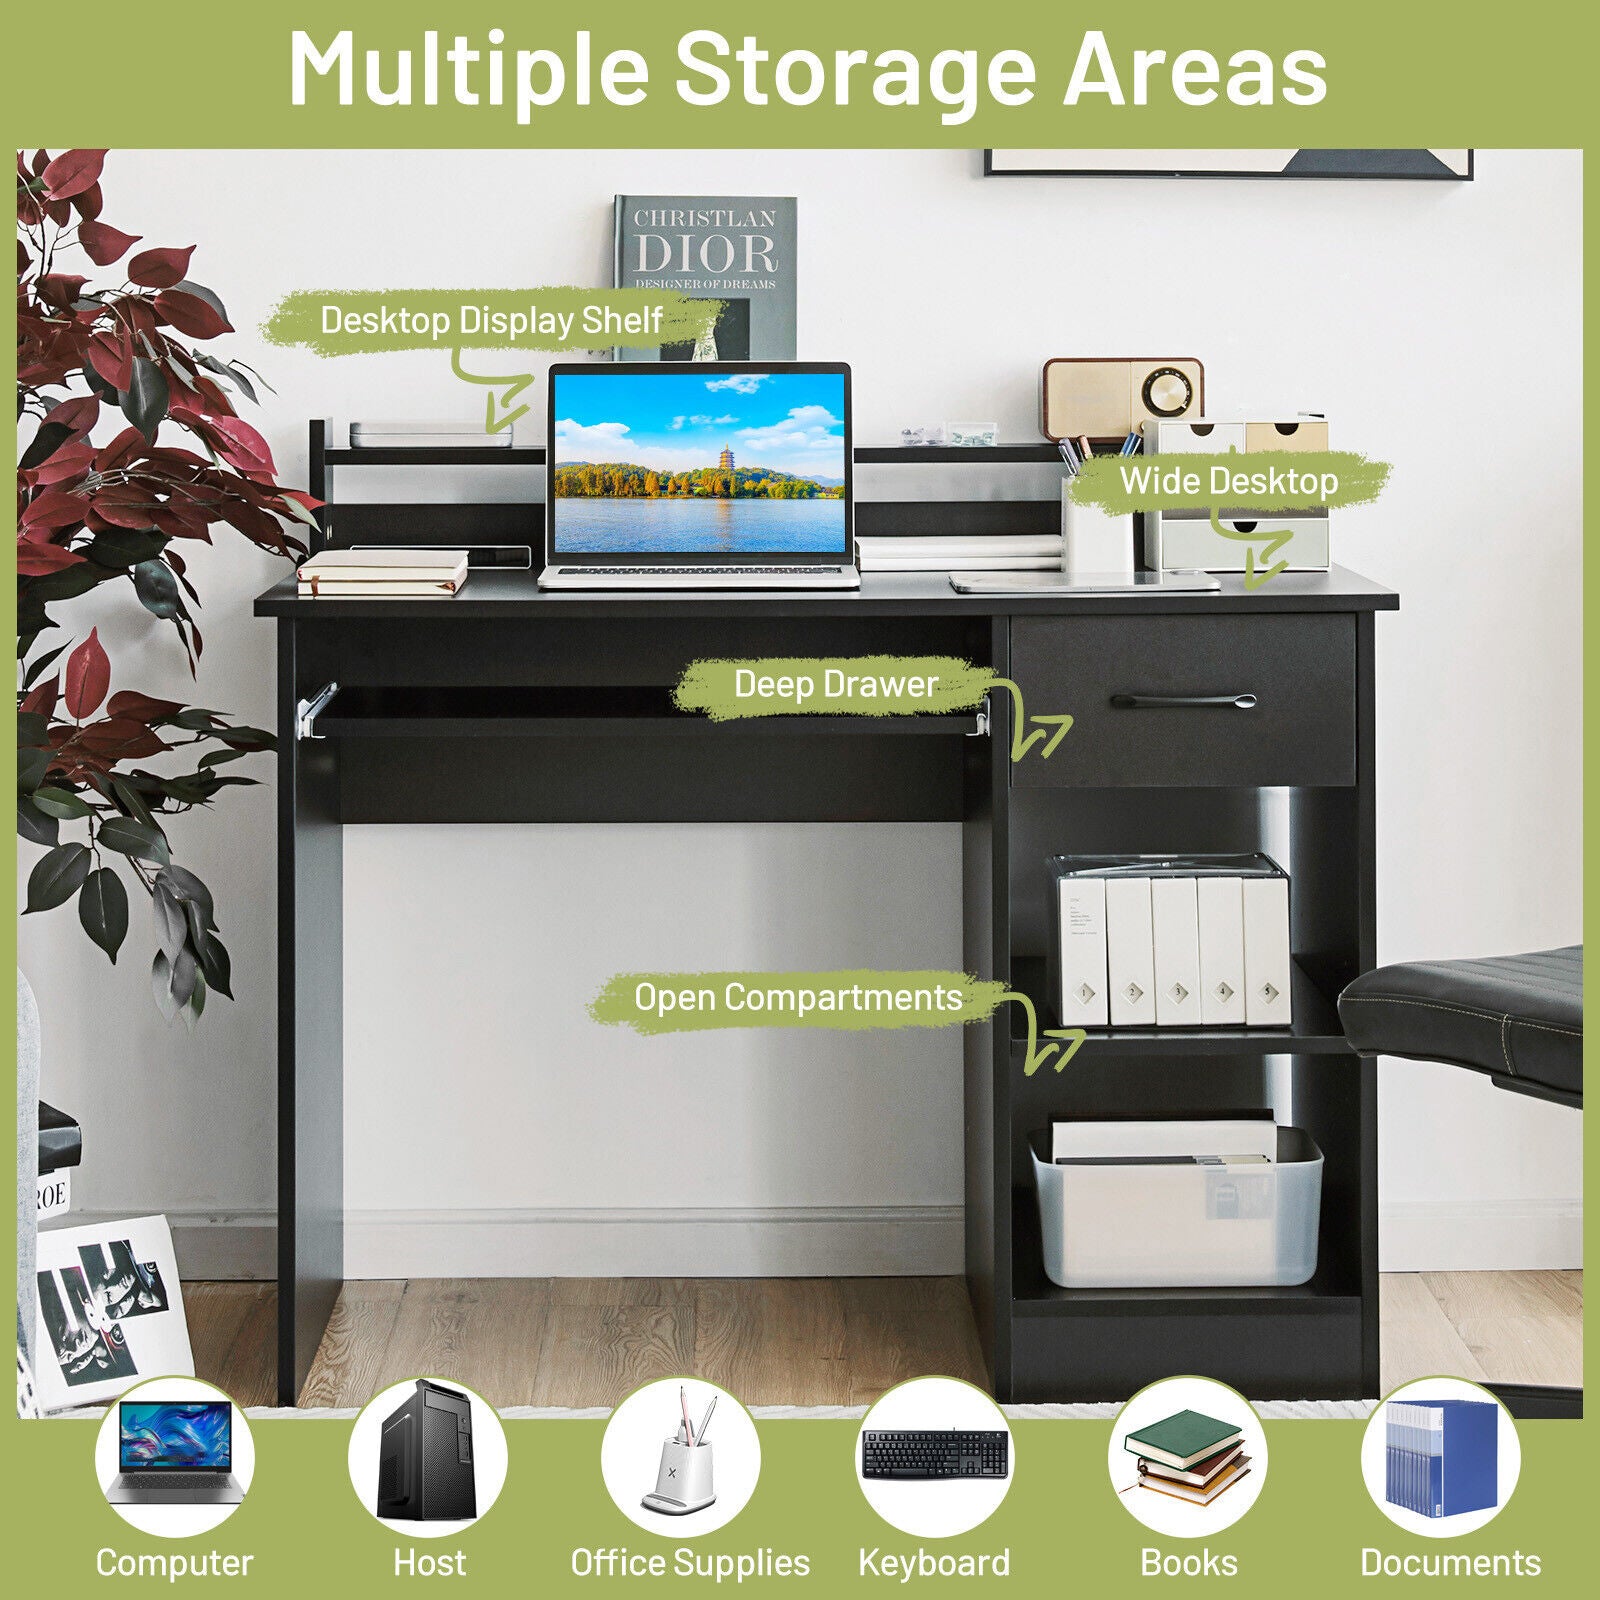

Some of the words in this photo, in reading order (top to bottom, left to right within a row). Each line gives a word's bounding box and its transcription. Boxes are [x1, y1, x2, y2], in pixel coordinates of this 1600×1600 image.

[632, 233, 779, 274] DIOR
[635, 279, 700, 290] DESIGNER
[703, 279, 720, 290] OF
[723, 279, 776, 290] DREAMS
